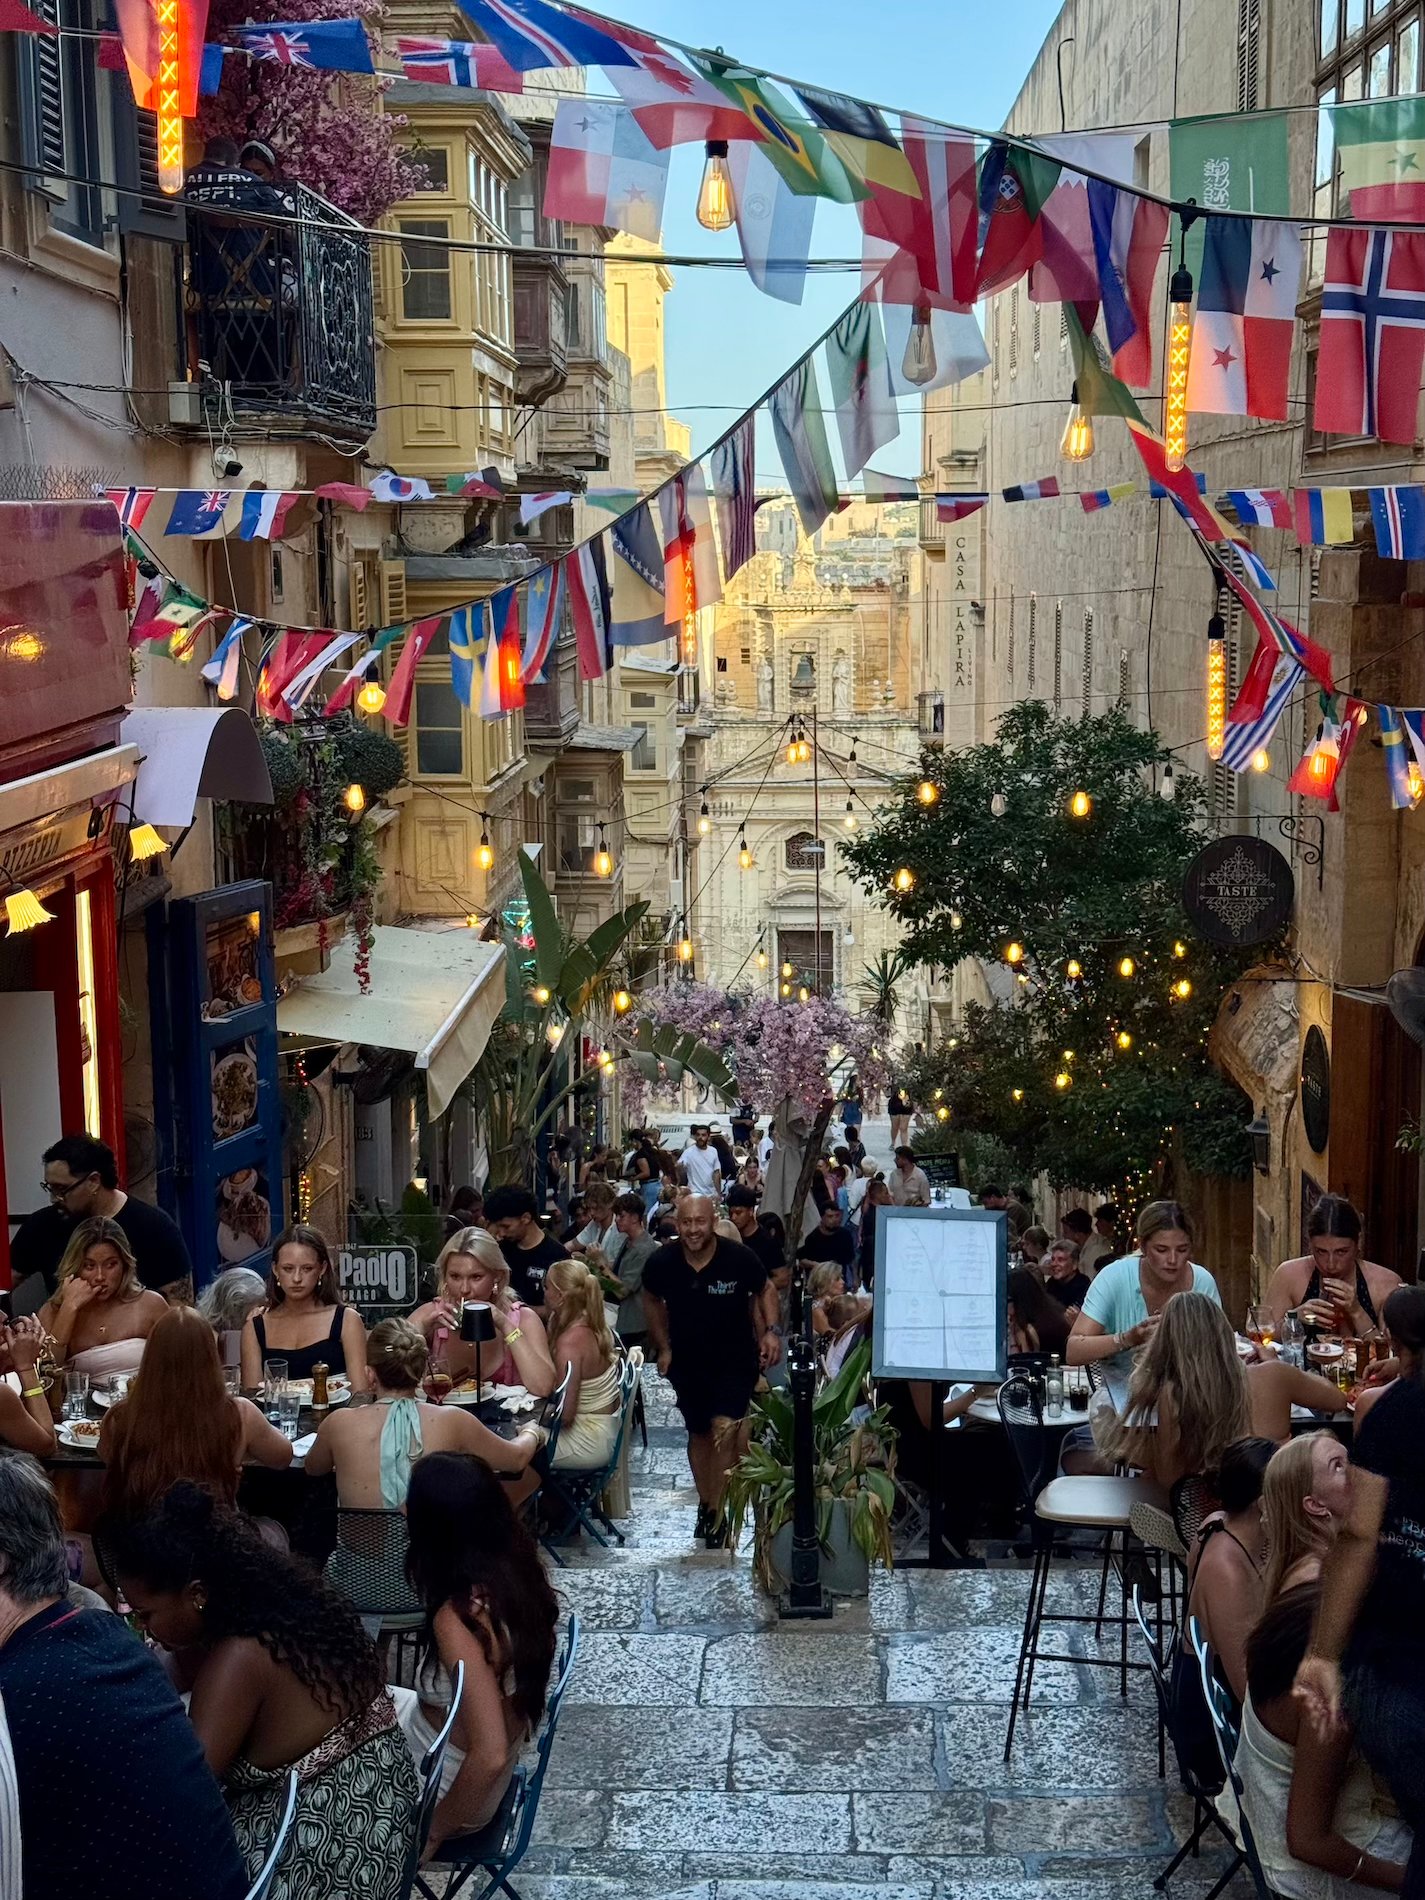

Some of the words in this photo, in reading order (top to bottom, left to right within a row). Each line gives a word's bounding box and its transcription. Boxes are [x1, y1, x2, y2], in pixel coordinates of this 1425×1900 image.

[955, 537, 966, 590] CASA
[955, 607, 966, 687] LAPIRA
[1217, 885, 1258, 897] TASTE
